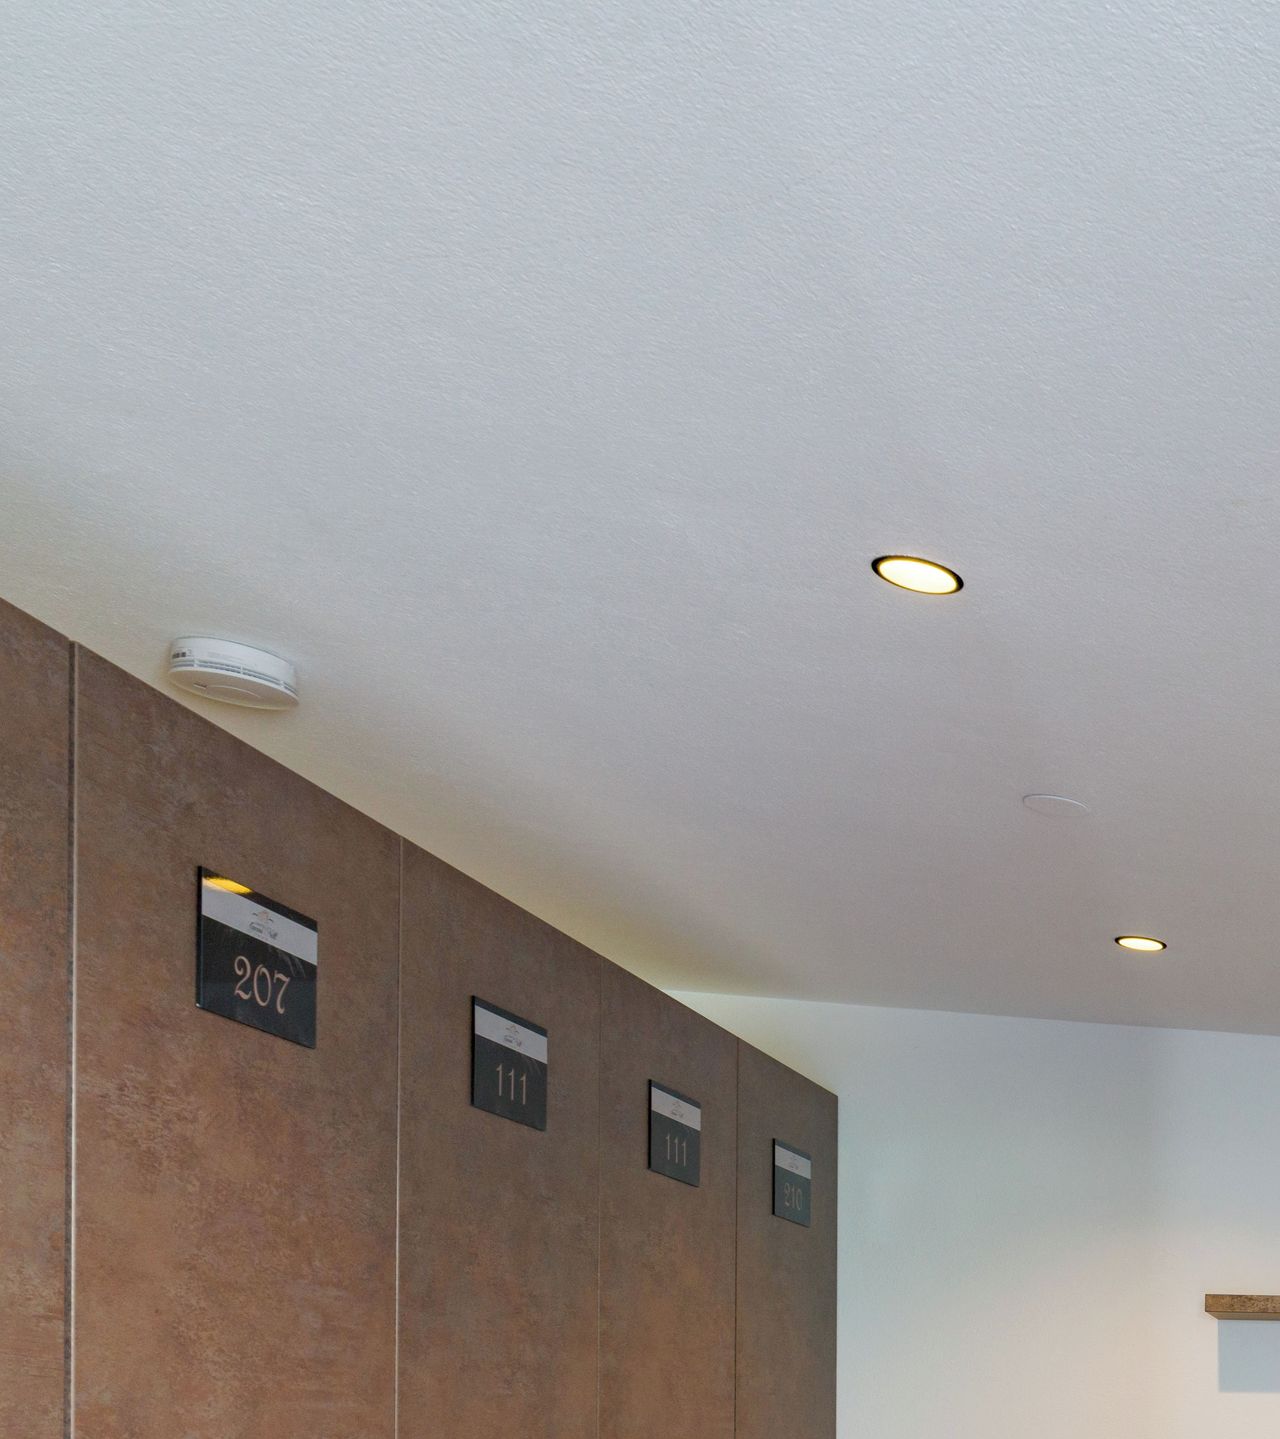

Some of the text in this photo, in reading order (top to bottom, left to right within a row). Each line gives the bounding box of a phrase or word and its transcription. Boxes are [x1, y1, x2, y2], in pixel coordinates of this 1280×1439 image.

[233, 955, 290, 1015] 207
[495, 1063, 528, 1105] 111
[665, 1132, 687, 1168] 111
